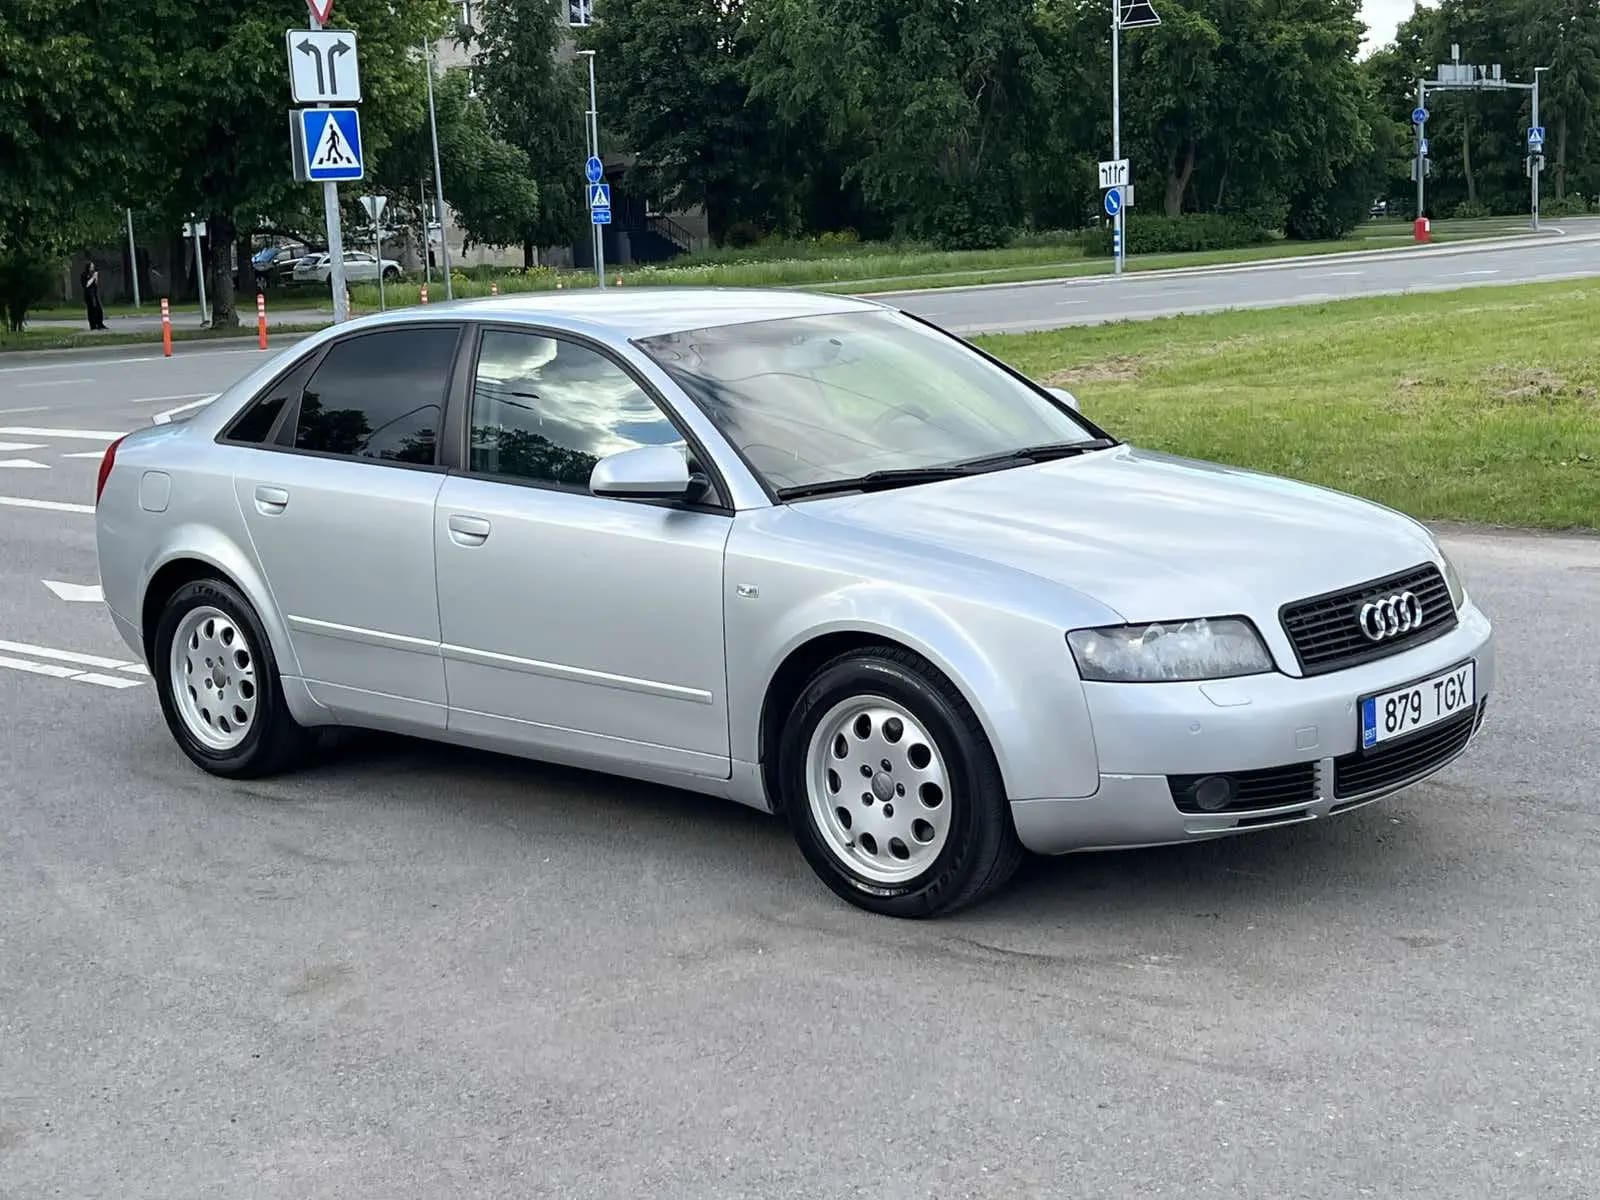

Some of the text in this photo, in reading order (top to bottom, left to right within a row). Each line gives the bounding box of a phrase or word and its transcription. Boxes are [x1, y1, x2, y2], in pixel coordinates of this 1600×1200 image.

[1385, 670, 1467, 733] 879 TGX
[1365, 727, 1376, 740] EST
